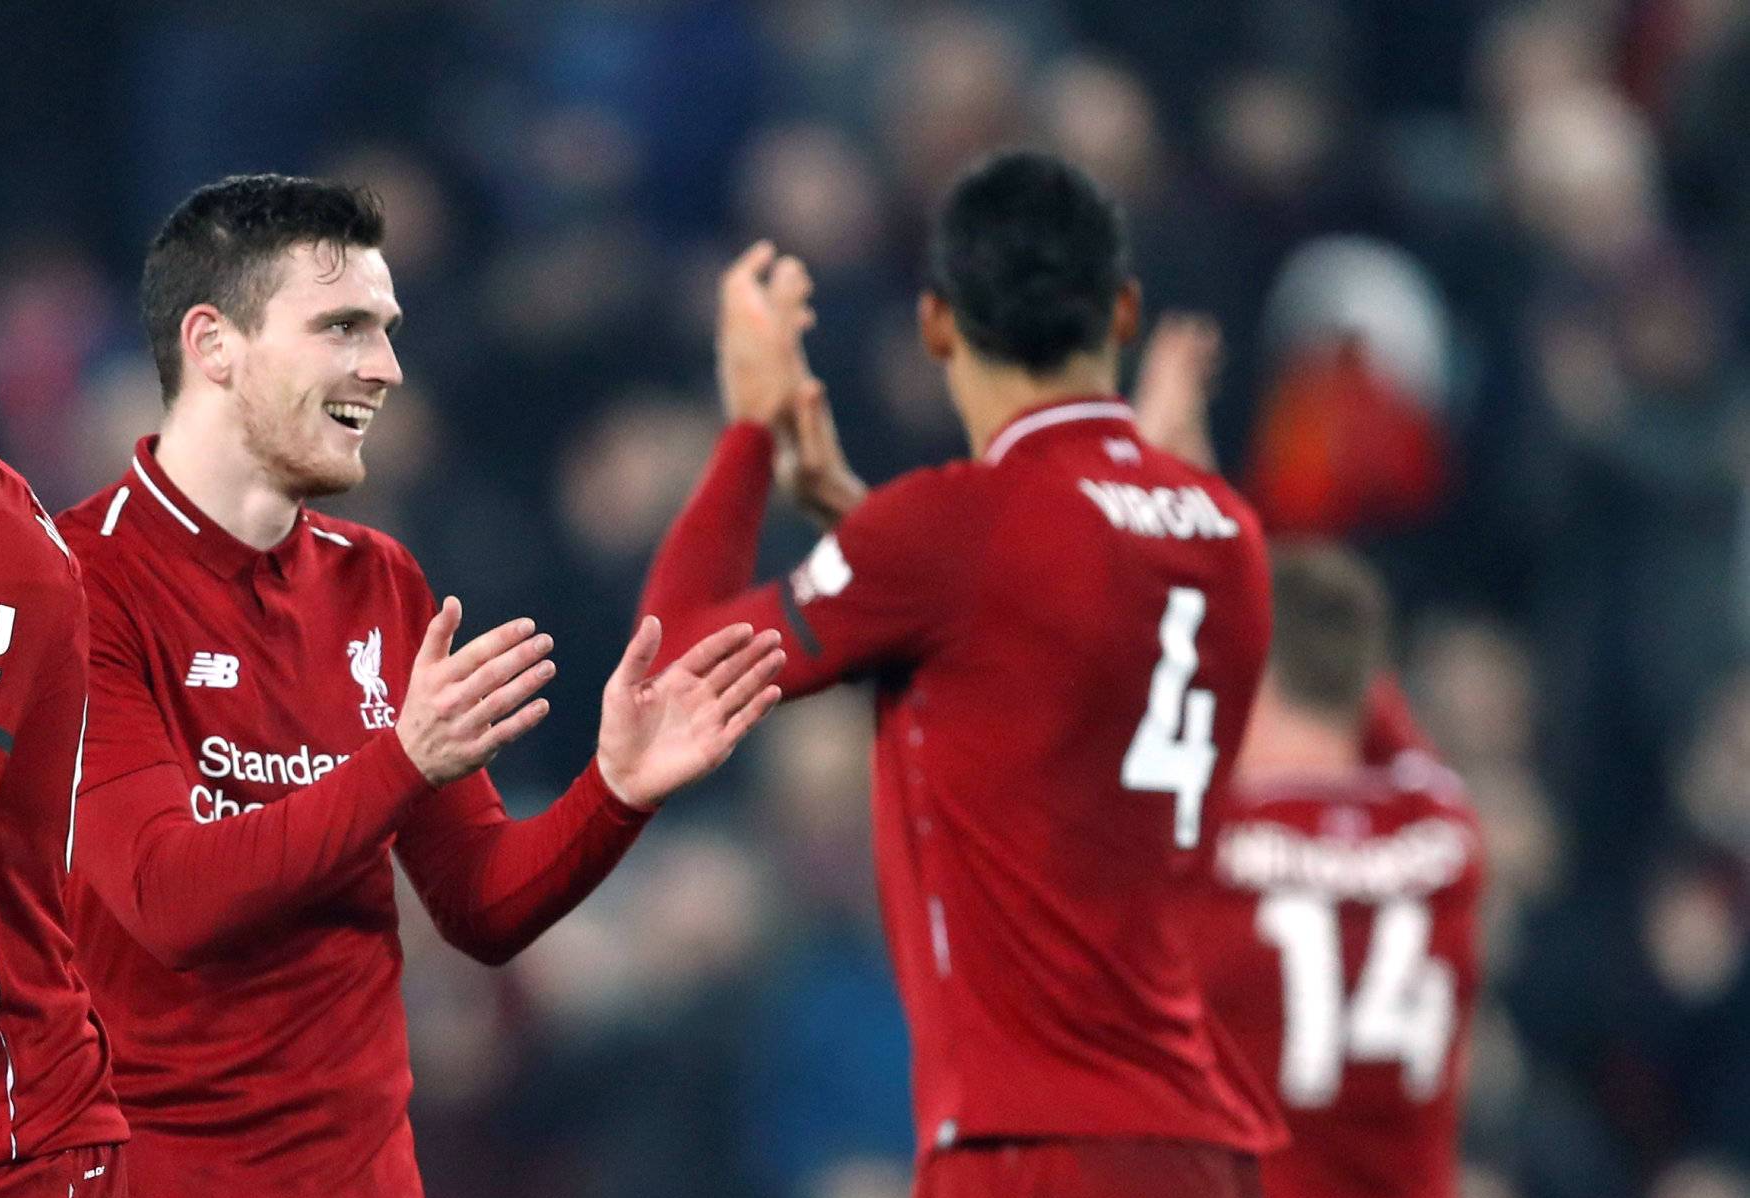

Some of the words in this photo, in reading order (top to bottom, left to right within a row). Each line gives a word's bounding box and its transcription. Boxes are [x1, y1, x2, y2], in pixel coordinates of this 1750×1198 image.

[198, 735, 351, 786] Standa
[1121, 586, 1218, 849] 4
[1253, 892, 1457, 1107] 14
